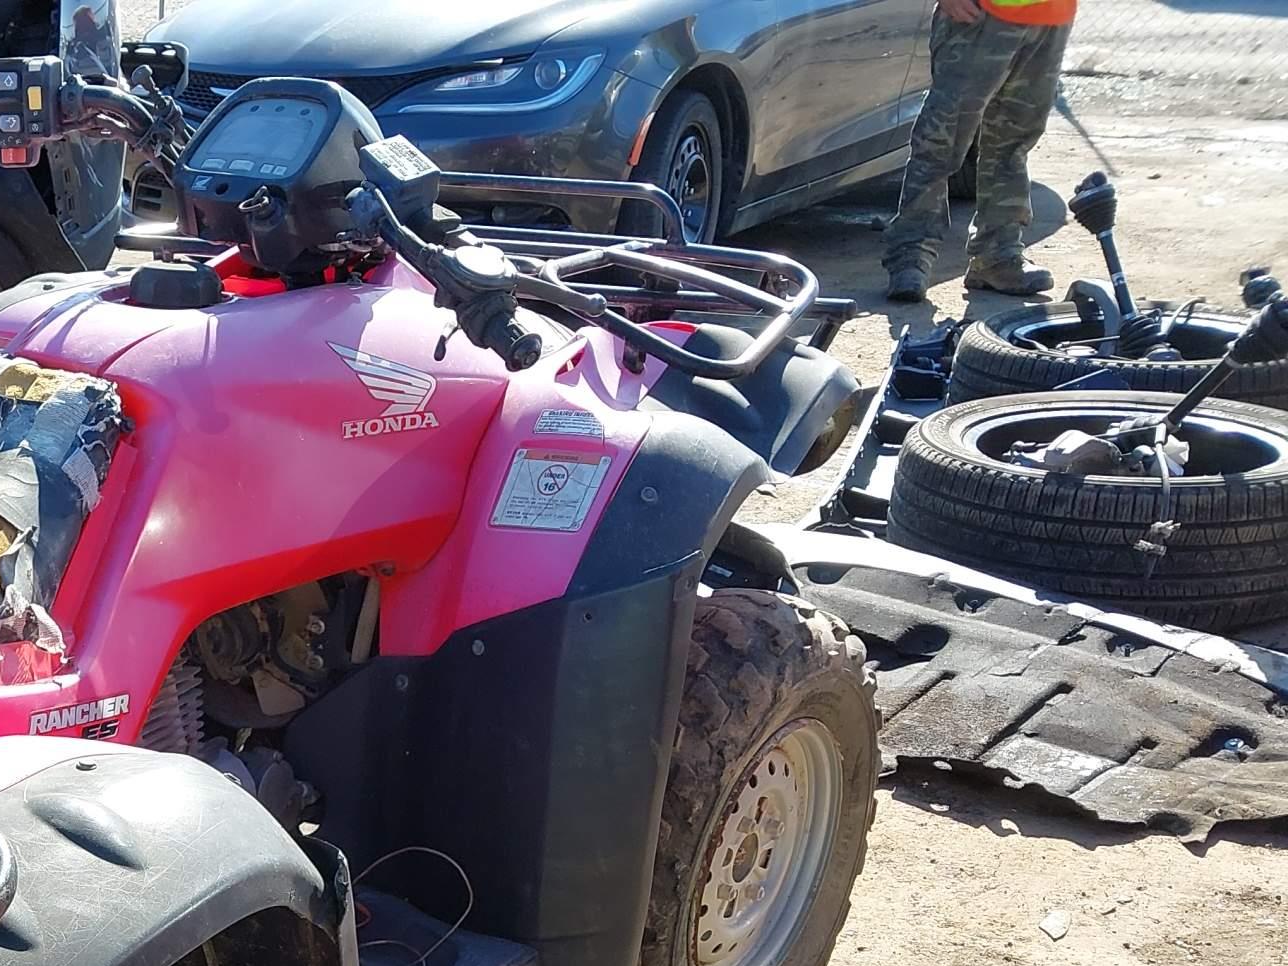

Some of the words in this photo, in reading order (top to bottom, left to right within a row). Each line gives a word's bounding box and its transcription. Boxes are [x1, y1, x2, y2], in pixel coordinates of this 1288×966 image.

[342, 411, 440, 439] HONDA
[543, 472, 566, 480] UNDER
[542, 482, 556, 492] 16
[29, 694, 131, 735] RANCHER
[81, 720, 120, 740] ES
